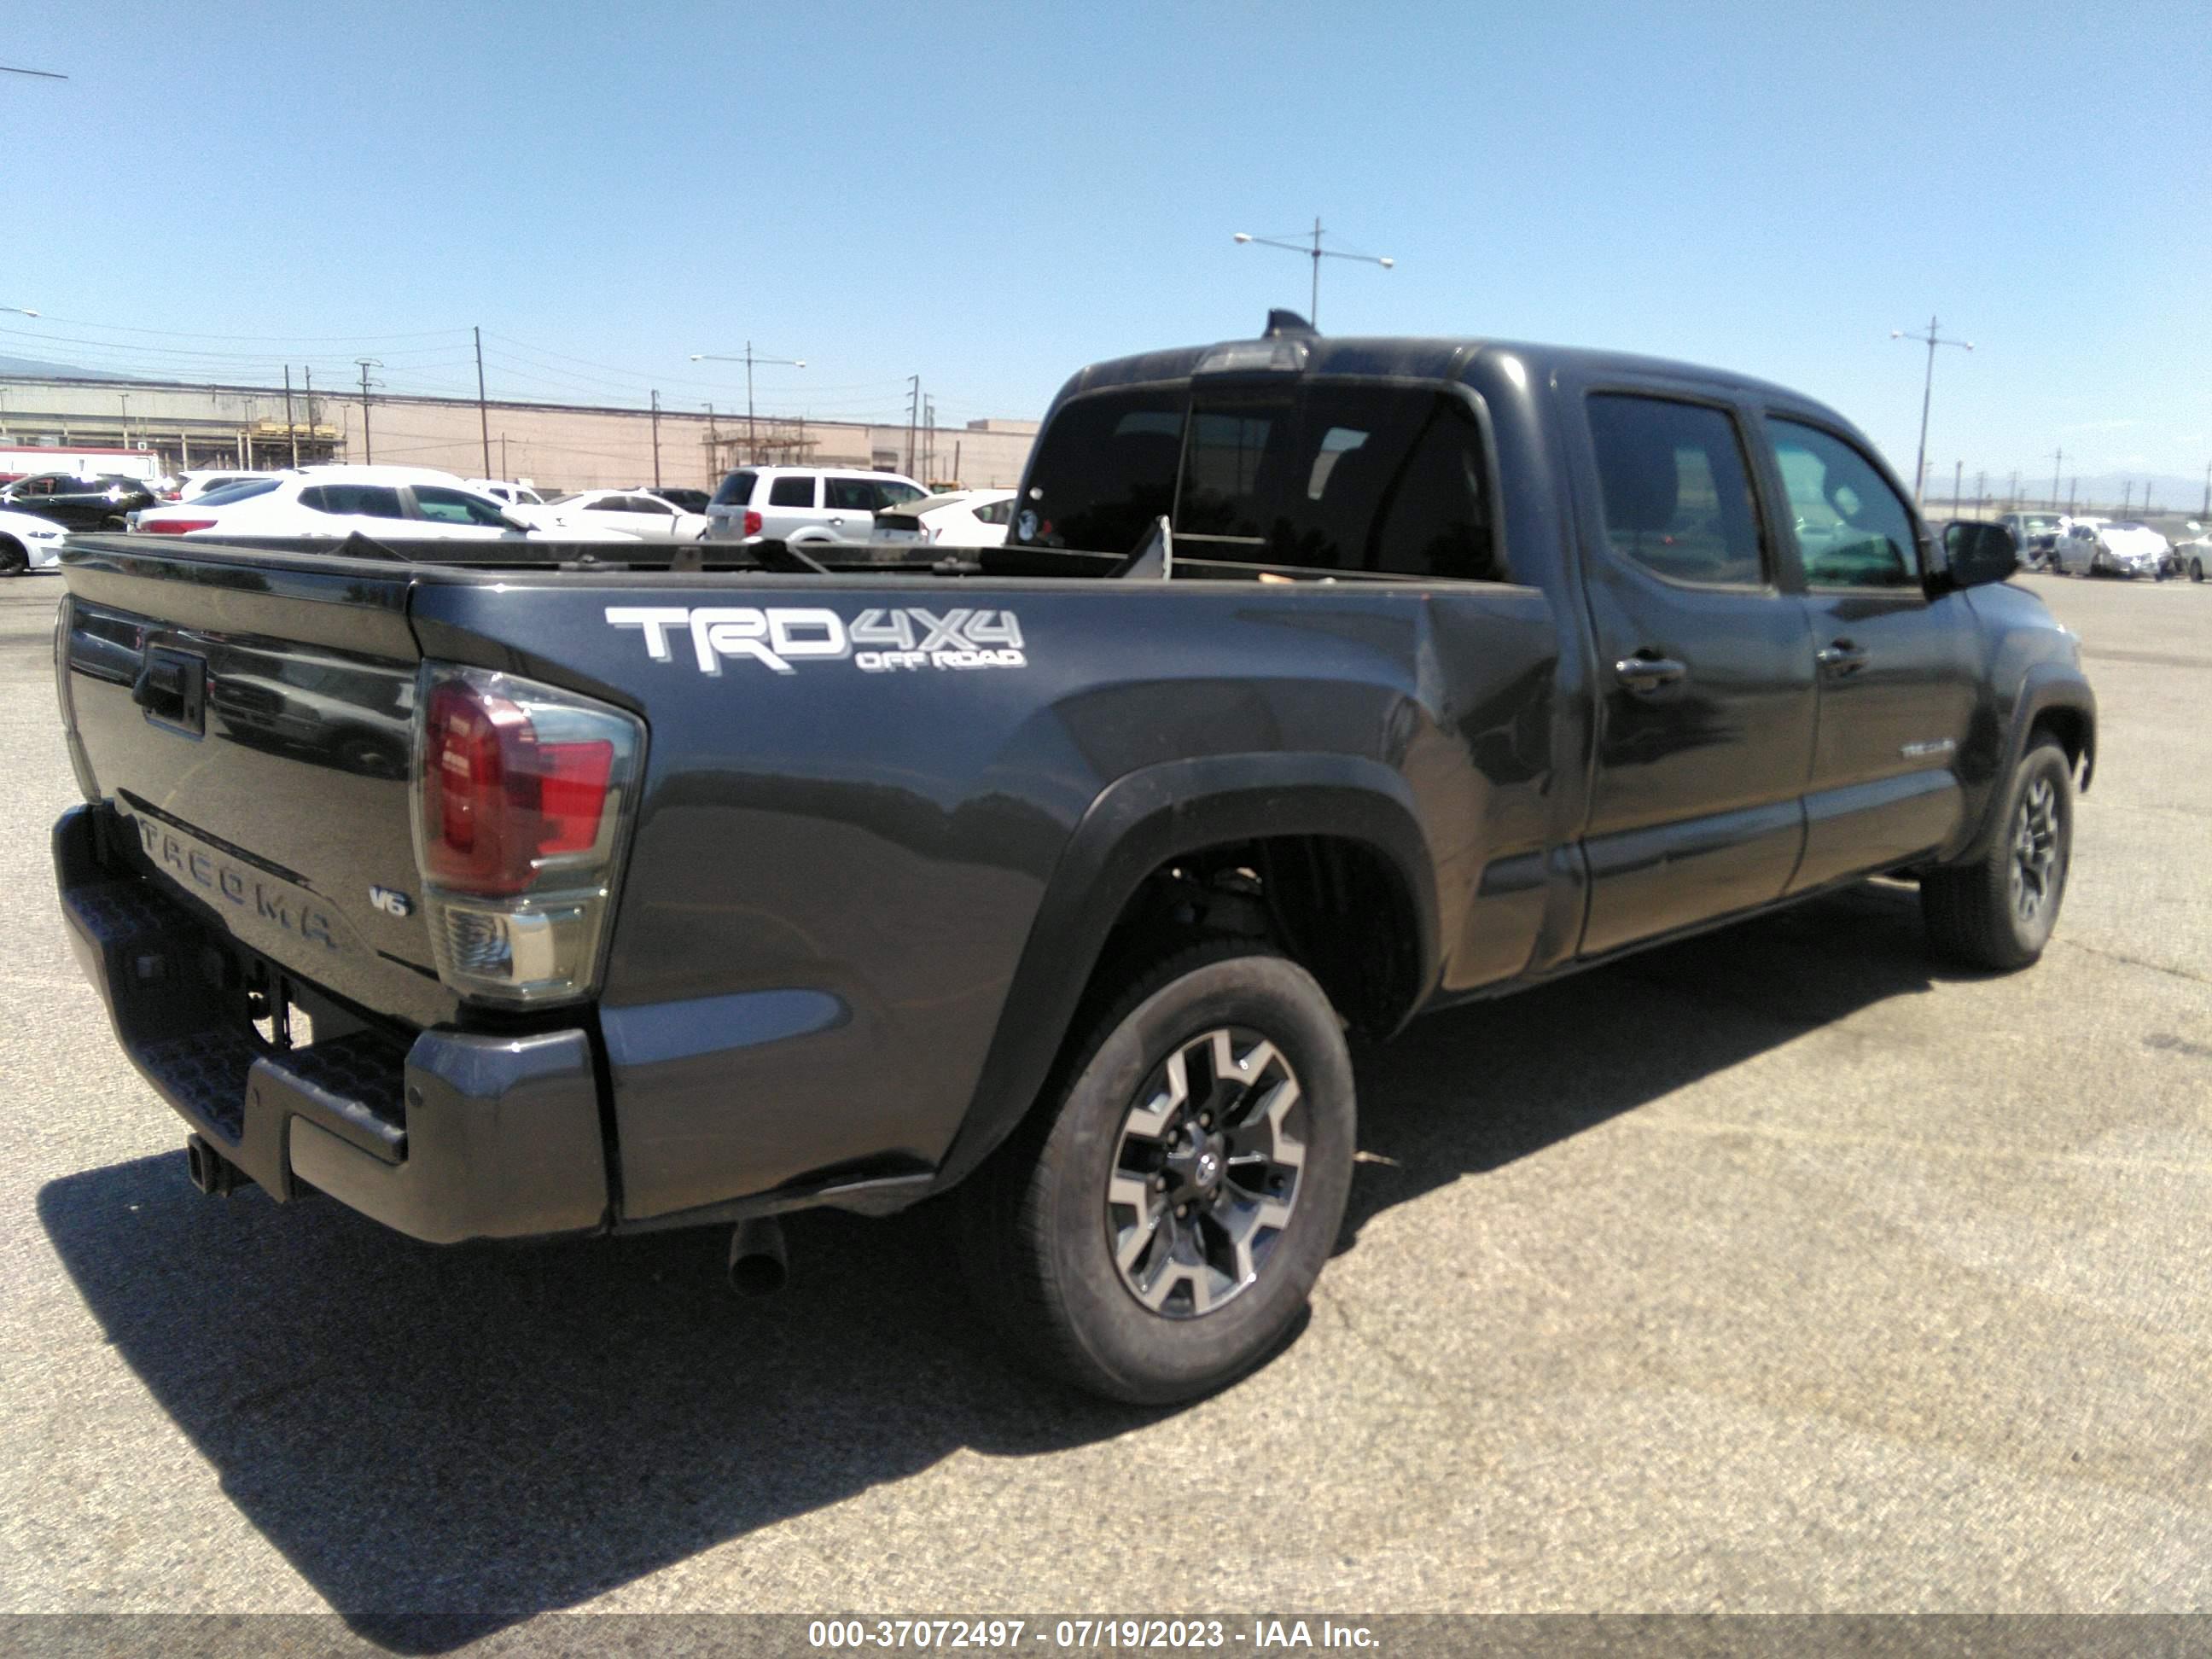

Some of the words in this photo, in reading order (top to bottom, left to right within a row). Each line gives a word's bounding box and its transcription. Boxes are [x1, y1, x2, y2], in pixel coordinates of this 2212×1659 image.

[604, 607, 853, 677] TRD
[855, 651, 928, 672] OFF
[931, 649, 1027, 671] ROAD
[369, 885, 408, 917] V6
